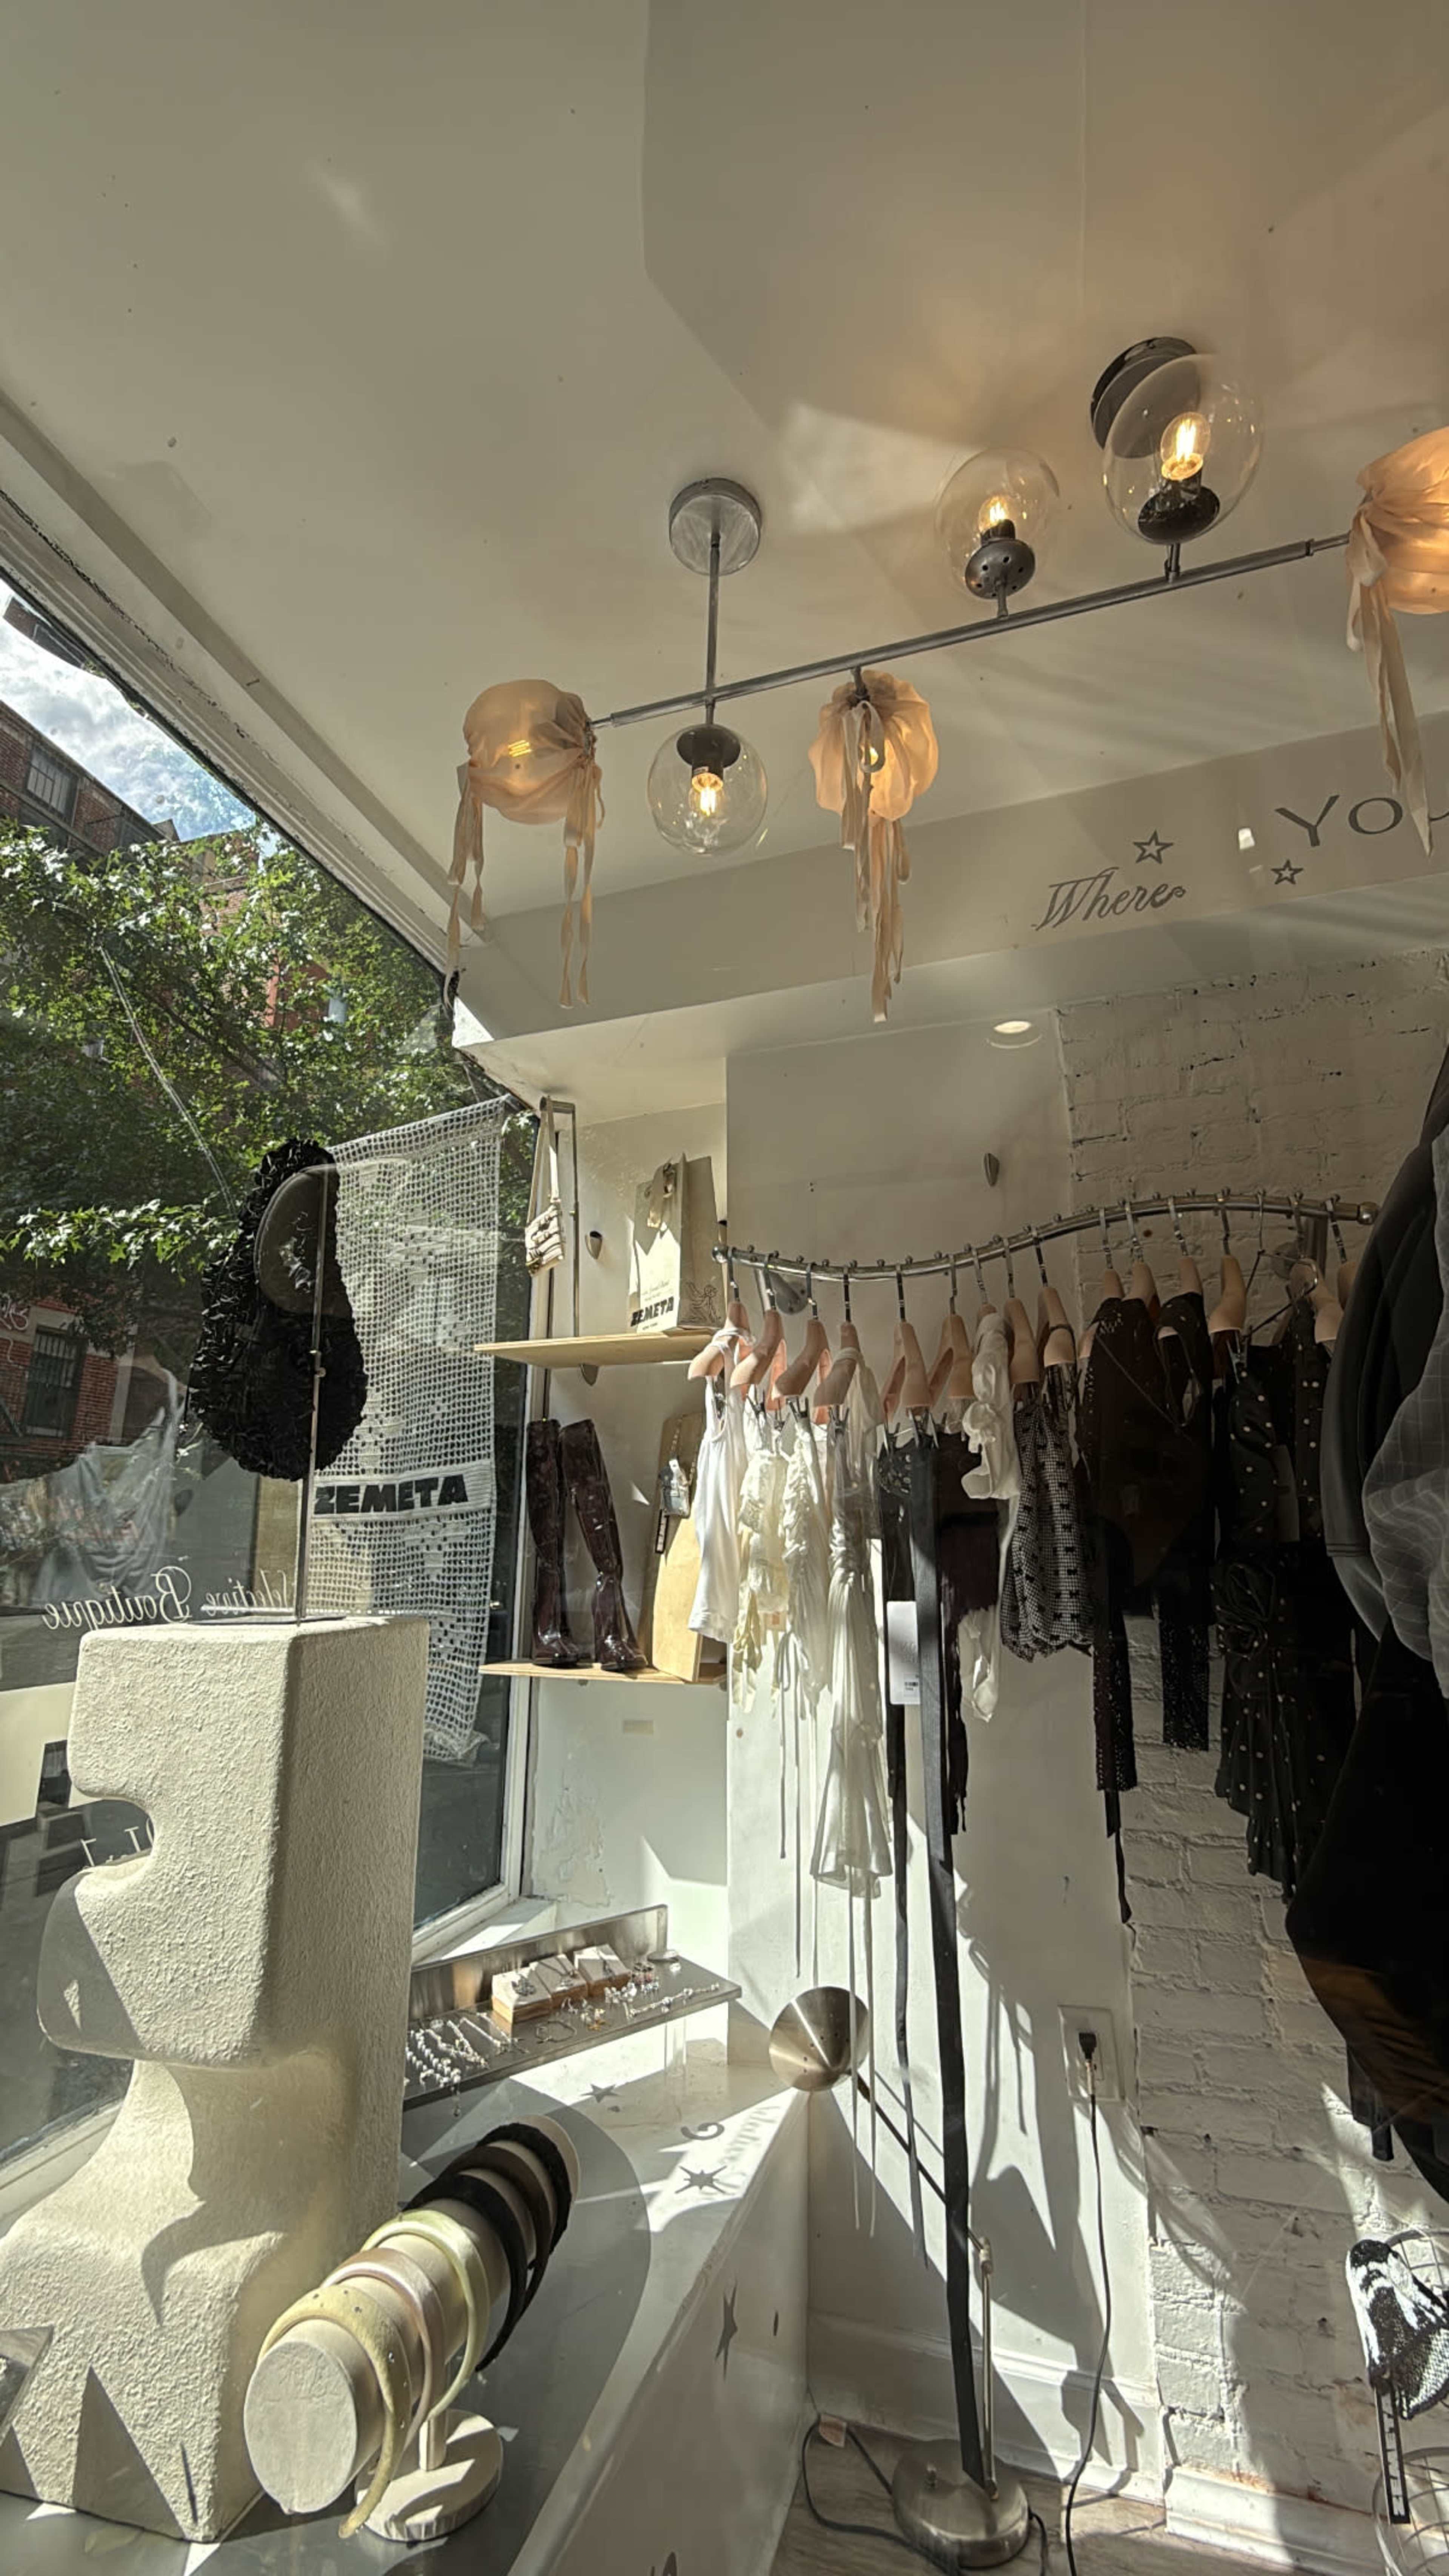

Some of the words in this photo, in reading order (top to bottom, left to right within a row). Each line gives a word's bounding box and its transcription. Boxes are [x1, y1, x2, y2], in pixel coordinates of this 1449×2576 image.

[1031, 867, 1186, 931] Where
[1275, 795, 1449, 846] YO
[631, 1296, 674, 1327] ZEMETA
[314, 1474, 468, 1514] ZEMETA
